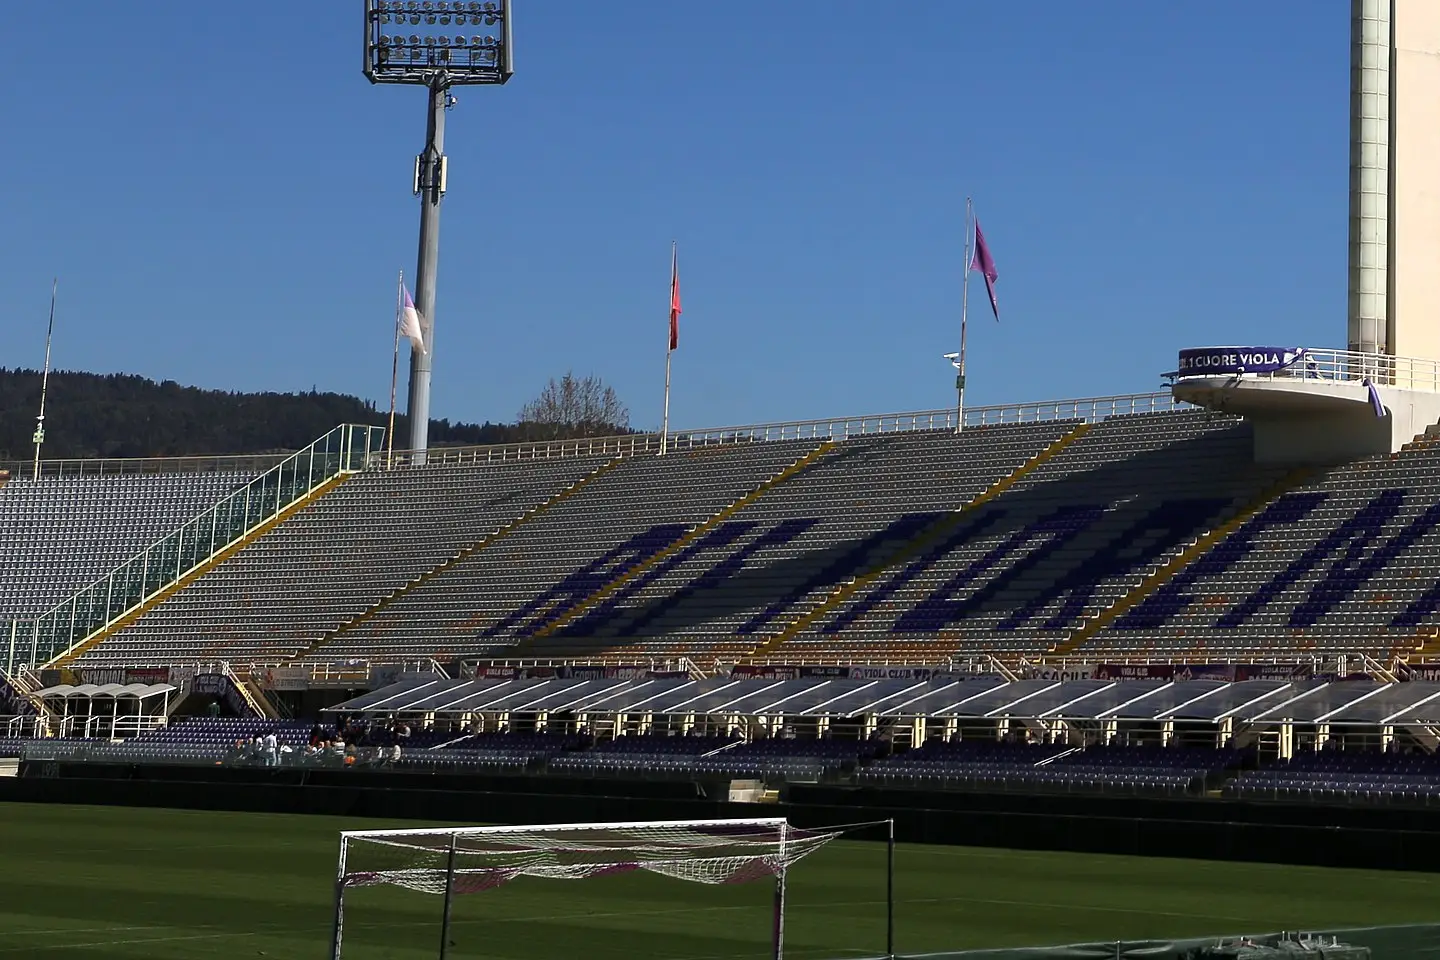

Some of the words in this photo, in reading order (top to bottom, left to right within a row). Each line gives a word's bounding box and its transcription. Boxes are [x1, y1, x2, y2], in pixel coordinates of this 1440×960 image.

[1195, 354, 1237, 368] CUORE
[1239, 352, 1280, 365] VIOLA
[864, 669, 885, 678] VIOLA
[888, 669, 911, 678] CLUB
